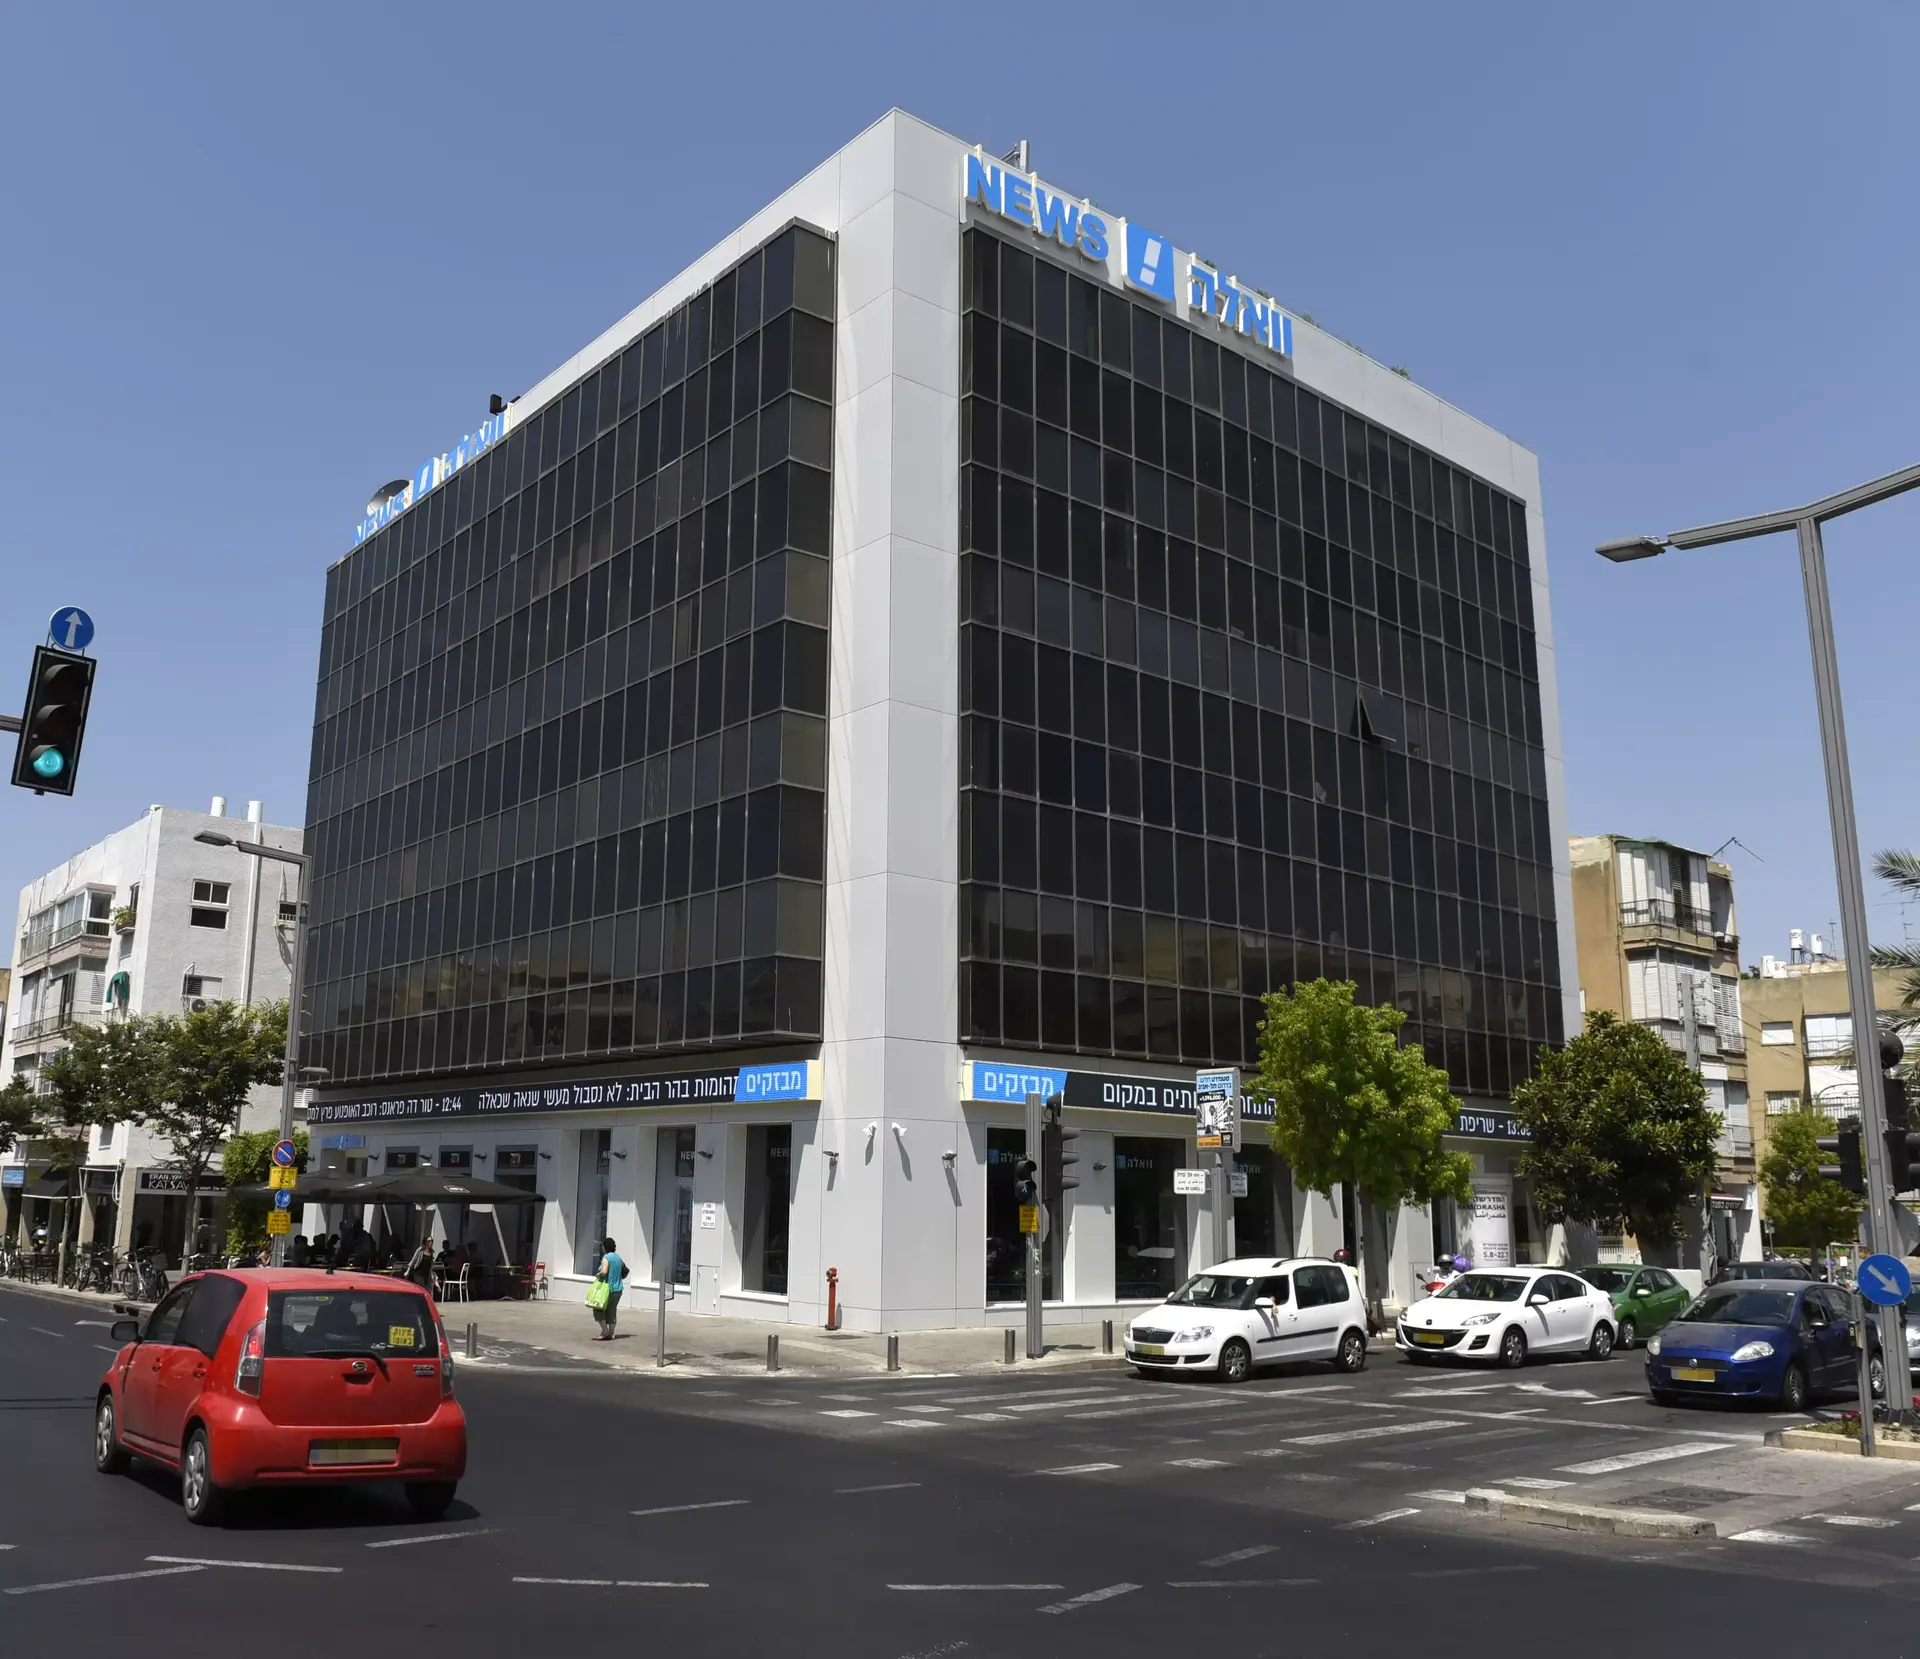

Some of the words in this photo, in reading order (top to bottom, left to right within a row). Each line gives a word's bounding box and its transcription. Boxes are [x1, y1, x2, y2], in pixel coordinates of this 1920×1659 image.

[964, 153, 1110, 262] NEWS
[1186, 263, 1294, 358] וואלה
[606, 1081, 622, 1103] לא
[626, 1082, 660, 1102] הבית:
[665, 1079, 690, 1099] בהר
[746, 1070, 801, 1096] מבזקים
[984, 1071, 1054, 1097] מבזקים
[441, 1096, 462, 1112] 12:44
[478, 1091, 511, 1110] שכאלה
[513, 1090, 540, 1108] שנאה
[543, 1088, 570, 1107] מעשי
[573, 1084, 603, 1105] נסבול
[1103, 1082, 1158, 1108] במקום
[361, 1102, 377, 1117] רוכב
[407, 1099, 418, 1114] דה
[420, 1098, 433, 1113] טור
[1459, 1115, 1495, 1134] שריפת
